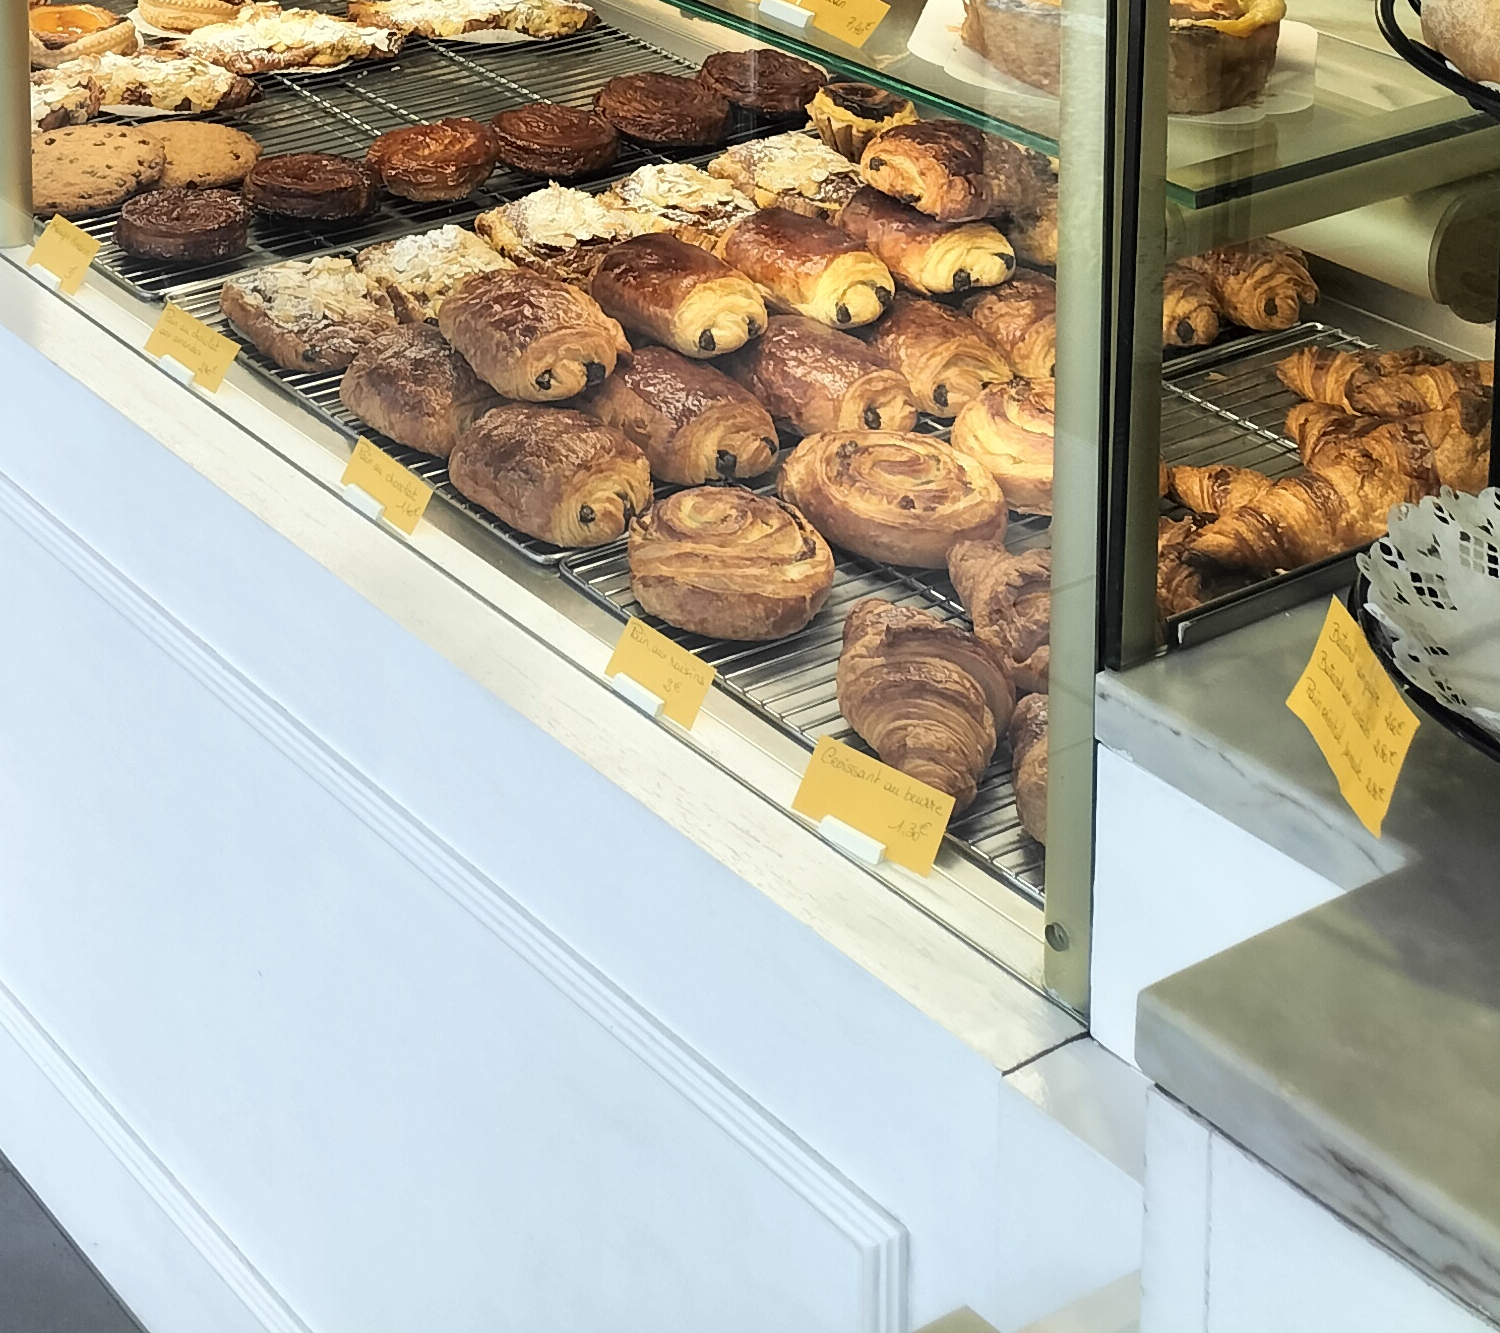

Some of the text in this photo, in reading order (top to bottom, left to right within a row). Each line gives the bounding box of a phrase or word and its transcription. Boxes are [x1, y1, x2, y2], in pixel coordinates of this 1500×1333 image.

[357, 441, 373, 464] Pain
[630, 621, 650, 649] Pain
[820, 746, 945, 817] Croissant au beurre
